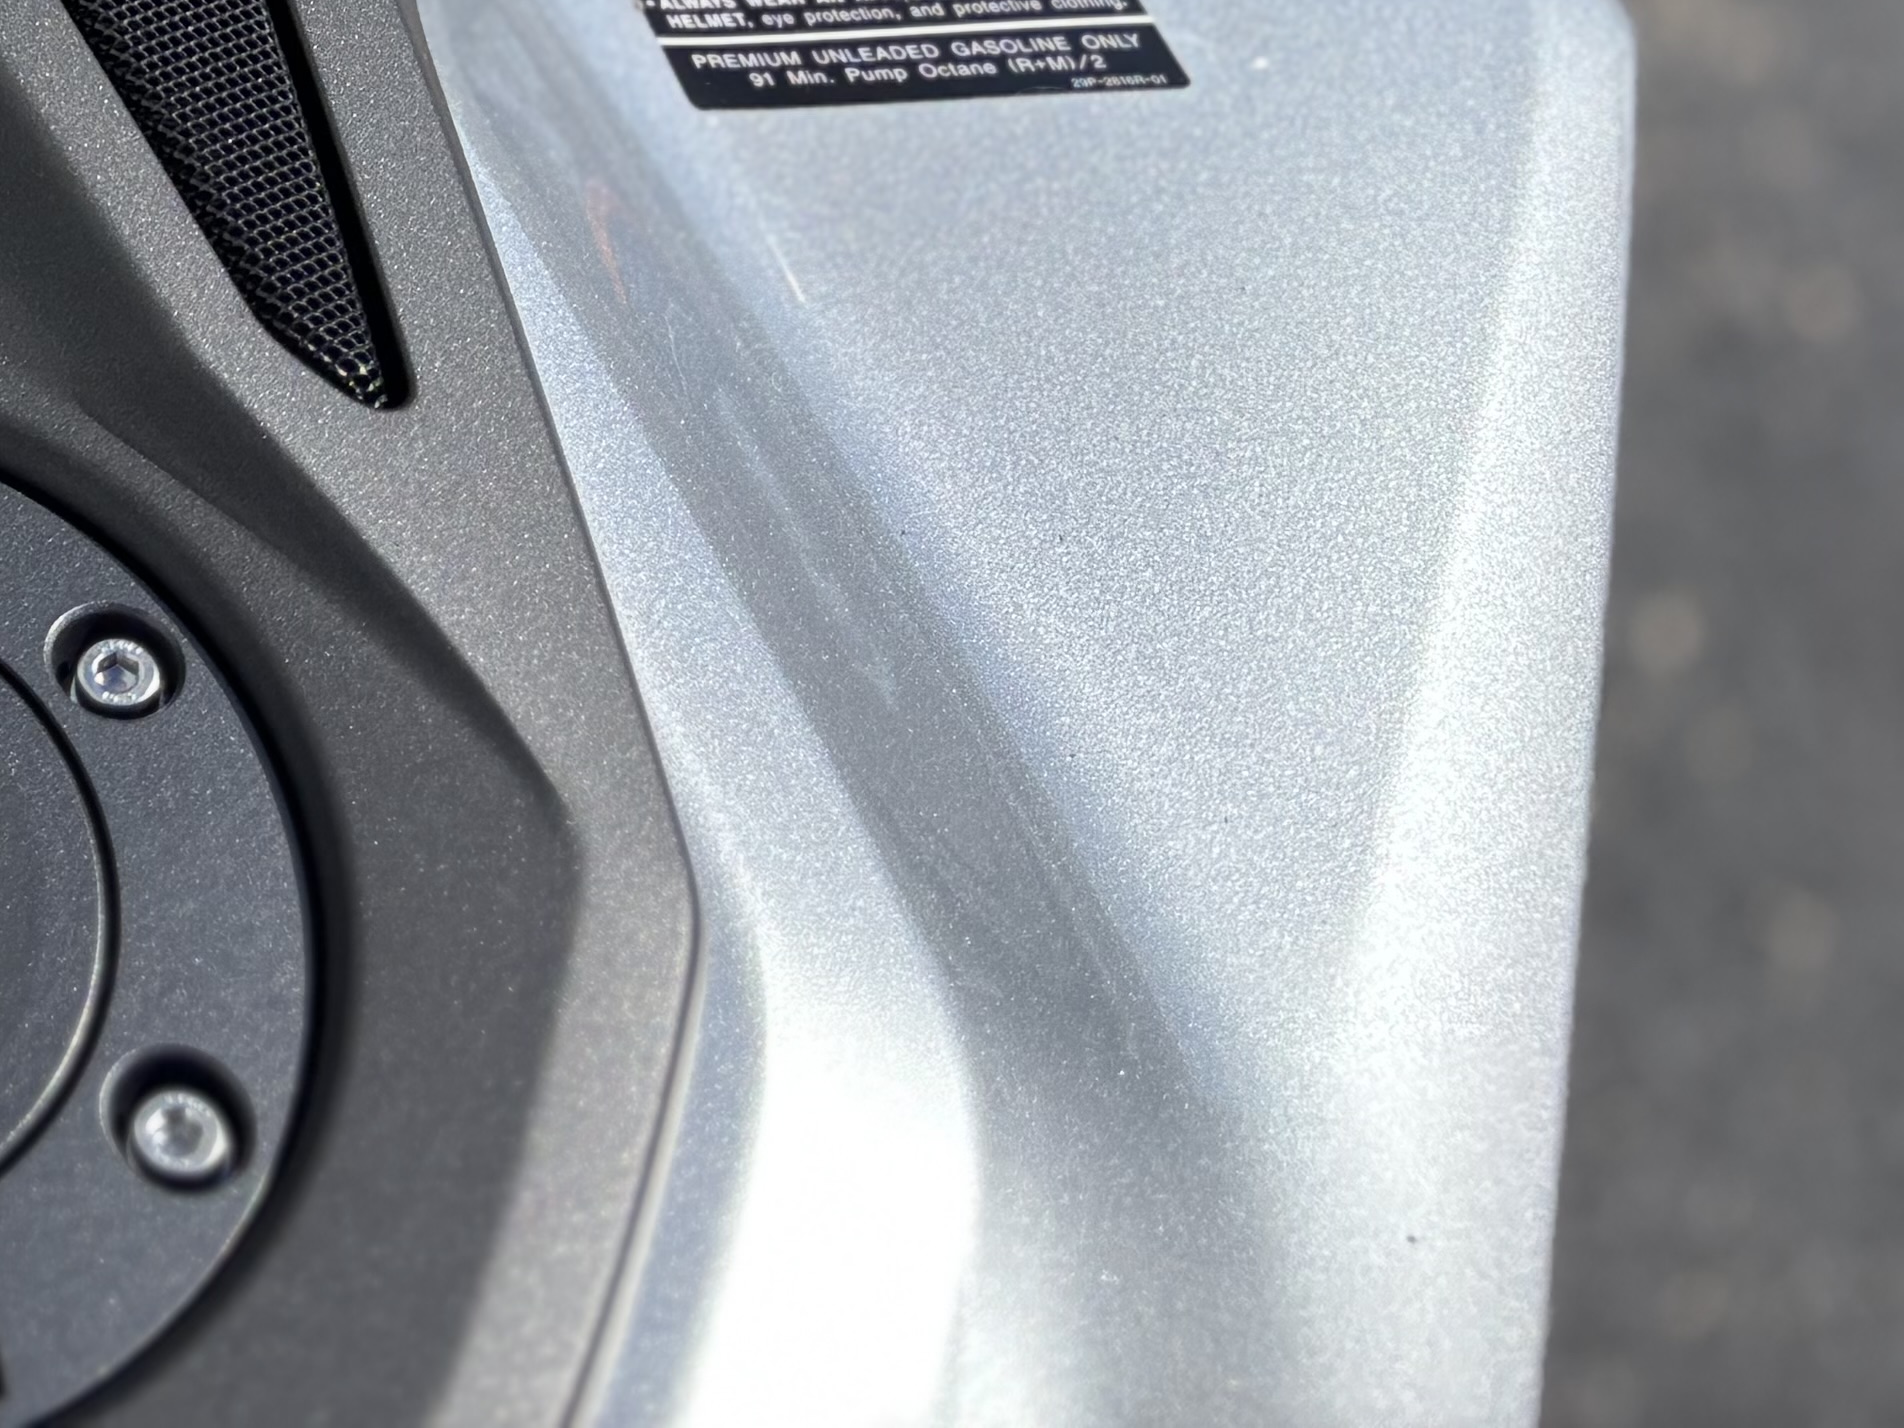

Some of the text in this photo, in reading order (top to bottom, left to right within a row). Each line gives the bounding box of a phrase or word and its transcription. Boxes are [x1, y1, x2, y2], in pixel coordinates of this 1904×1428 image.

[666, 10, 754, 30] HELMET,
[761, 12, 794, 27] eye
[803, 7, 902, 28] protection,
[910, 1, 945, 18] and
[691, 32, 1142, 70] PREMIUM UNLEADED GASOLINE ONLY
[749, 53, 1108, 89] 91 Min. Pump Octane (R+M)/2
